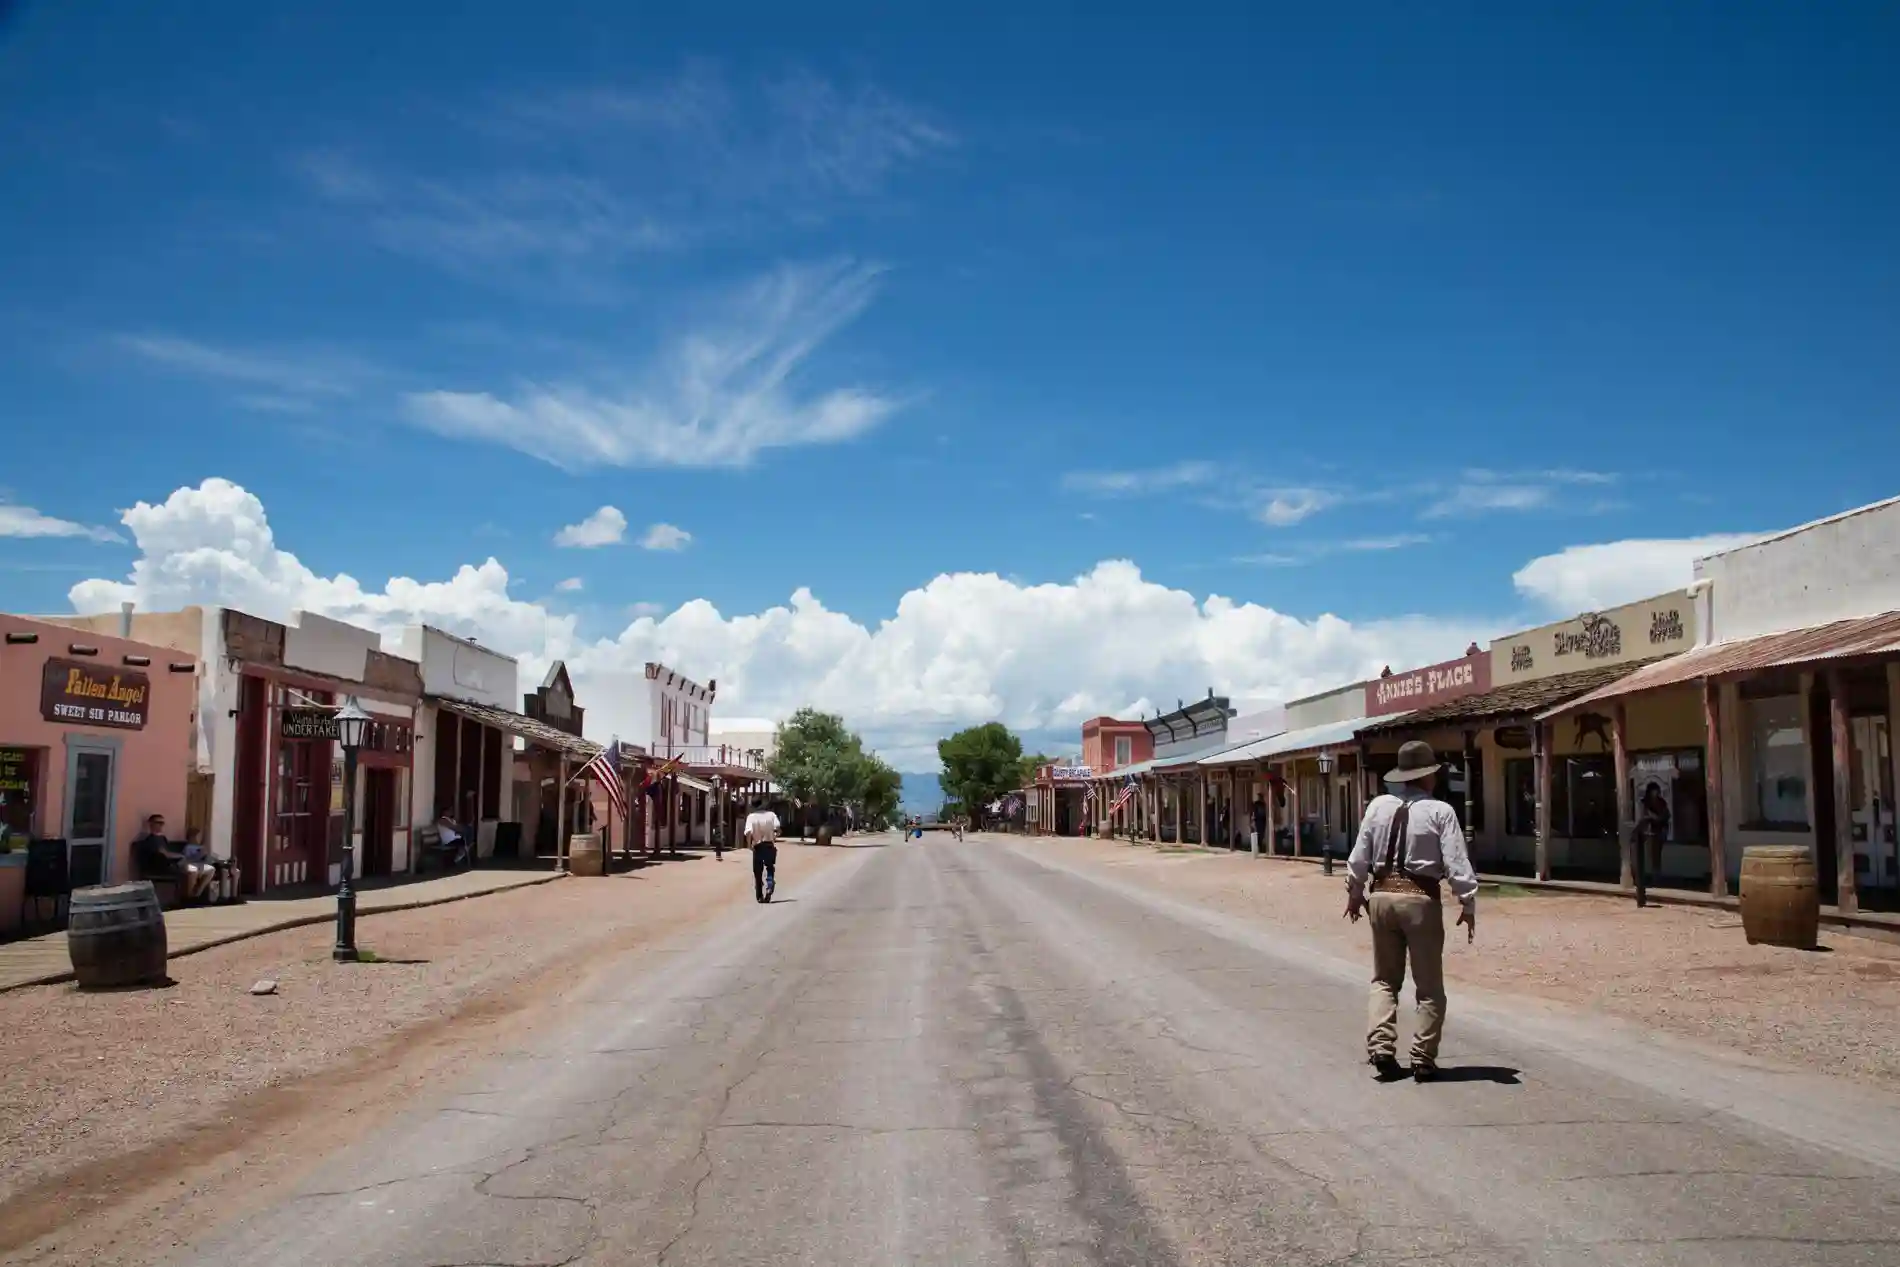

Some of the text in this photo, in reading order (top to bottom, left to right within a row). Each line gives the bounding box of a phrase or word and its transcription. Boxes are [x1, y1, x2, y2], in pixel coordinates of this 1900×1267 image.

[65, 667, 145, 707] Fallen Angel
[1377, 663, 1473, 704] ANNIE'S PLACE
[54, 703, 141, 724] SWEET SIN PARLOR
